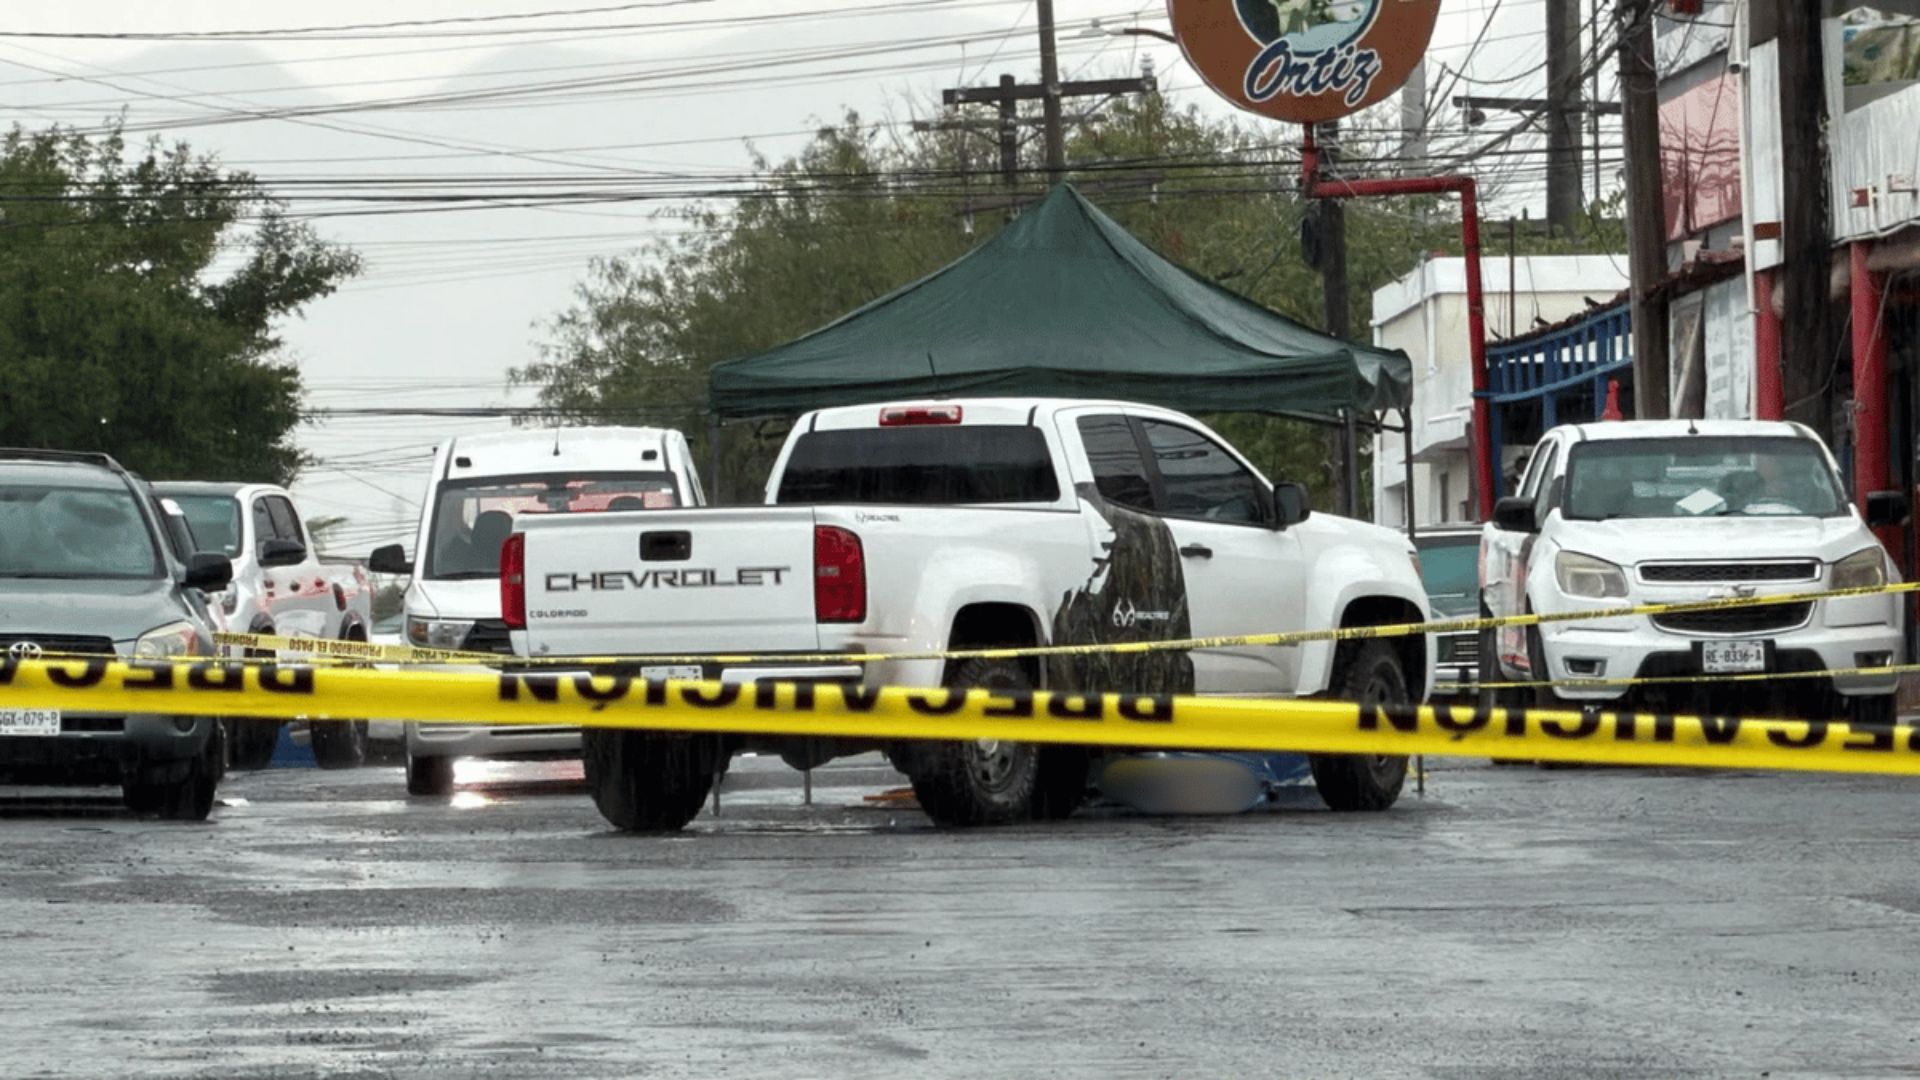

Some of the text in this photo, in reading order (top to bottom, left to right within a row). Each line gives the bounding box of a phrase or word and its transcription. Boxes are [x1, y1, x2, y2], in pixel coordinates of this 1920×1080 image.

[1244, 38, 1382, 107] Ortiz
[545, 567, 791, 592] CHEVROLET
[529, 609, 588, 618] COLORADO
[289, 638, 315, 651] PASO
